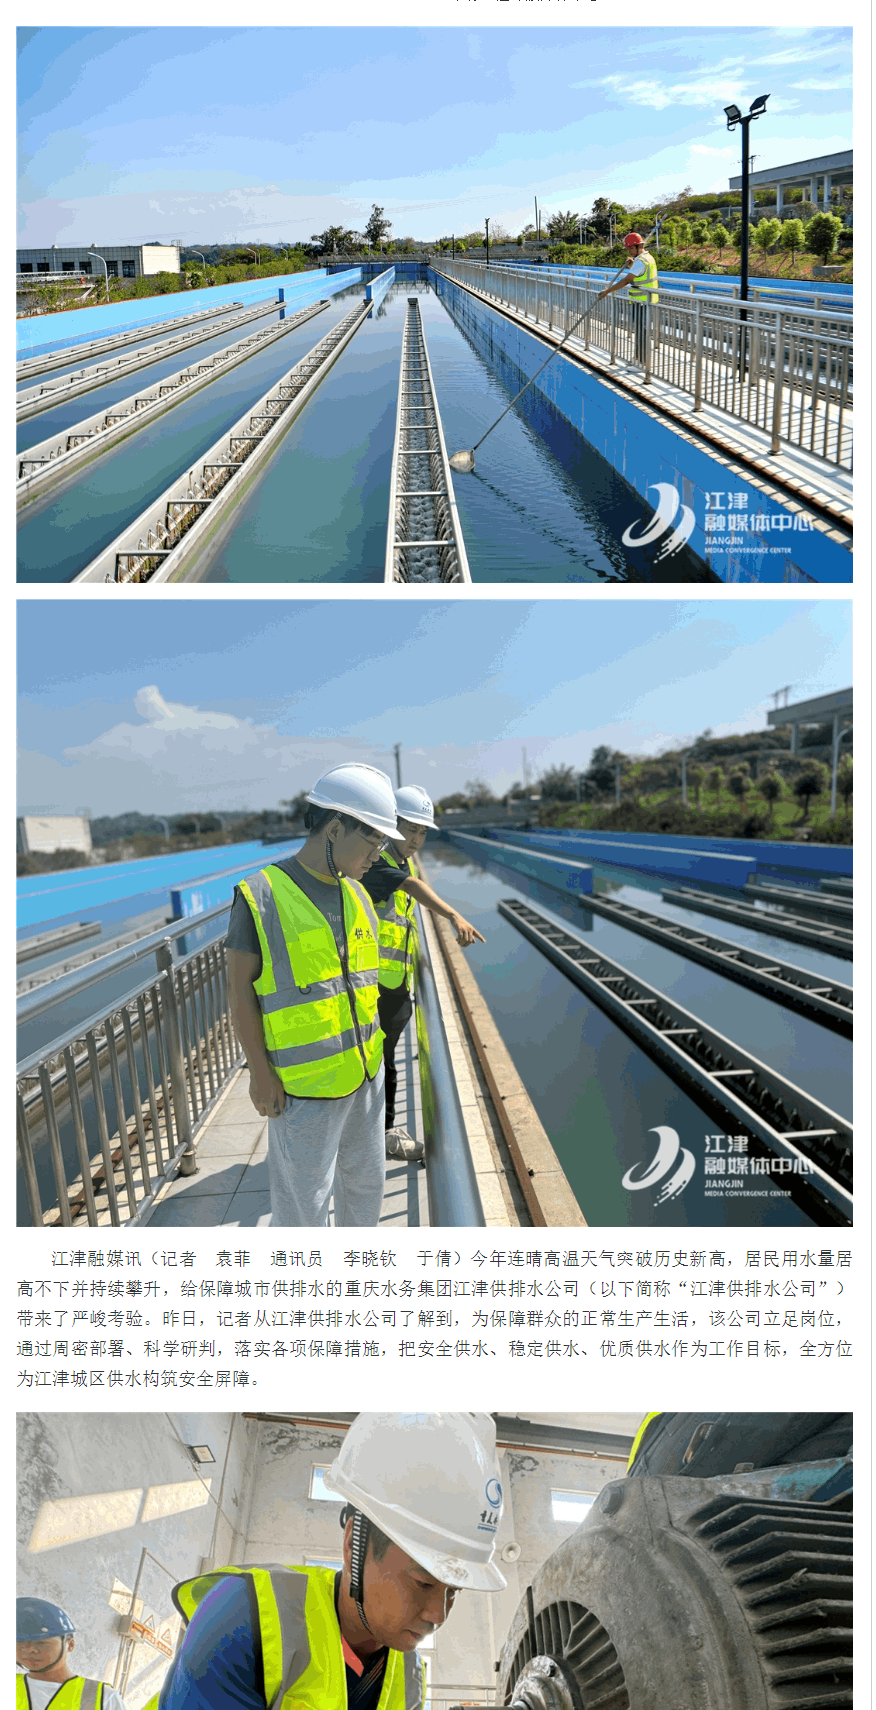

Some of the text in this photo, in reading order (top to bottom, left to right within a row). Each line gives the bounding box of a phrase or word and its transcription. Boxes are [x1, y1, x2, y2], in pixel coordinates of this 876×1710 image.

[51, 1249, 197, 1268] 江津融媒讯（记者
[216, 1249, 251, 1268] 袁菲
[270, 1249, 322, 1268] 通讯员
[343, 1249, 397, 1268] 李晓钦
[16, 1369, 257, 1388] 为江津城区供水构筑安全屏障。
